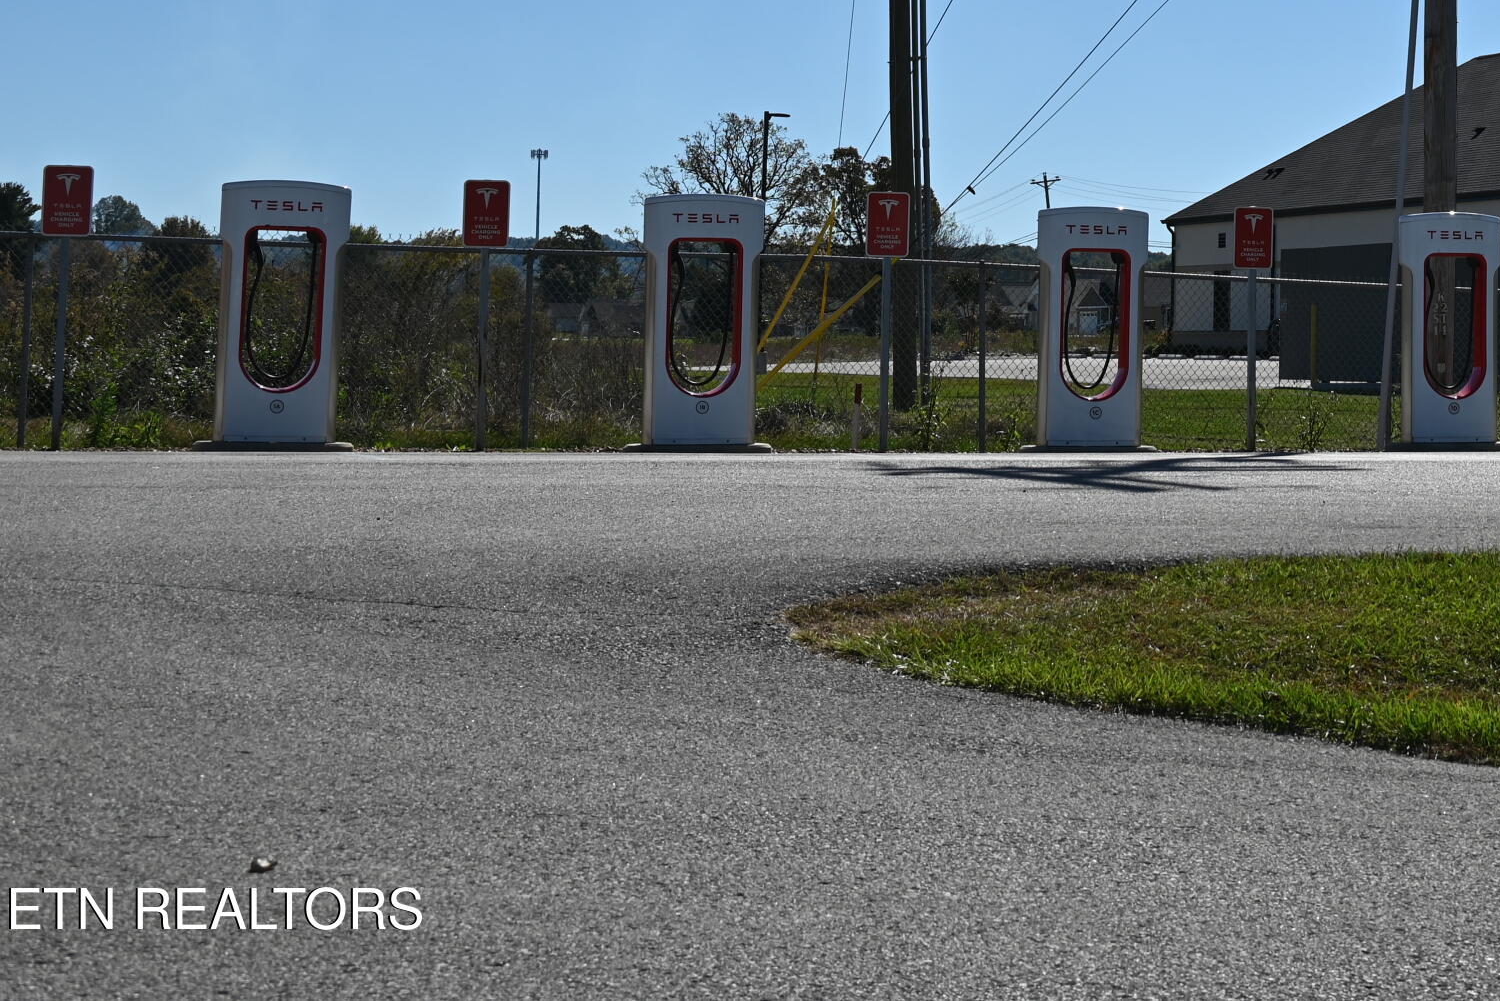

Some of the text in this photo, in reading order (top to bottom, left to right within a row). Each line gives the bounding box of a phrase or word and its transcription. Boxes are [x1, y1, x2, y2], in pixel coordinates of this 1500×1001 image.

[250, 199, 323, 212] TESLA
[672, 213, 740, 224] TESLA
[1065, 224, 1127, 236] TESLA
[1427, 230, 1484, 240] TESLA
